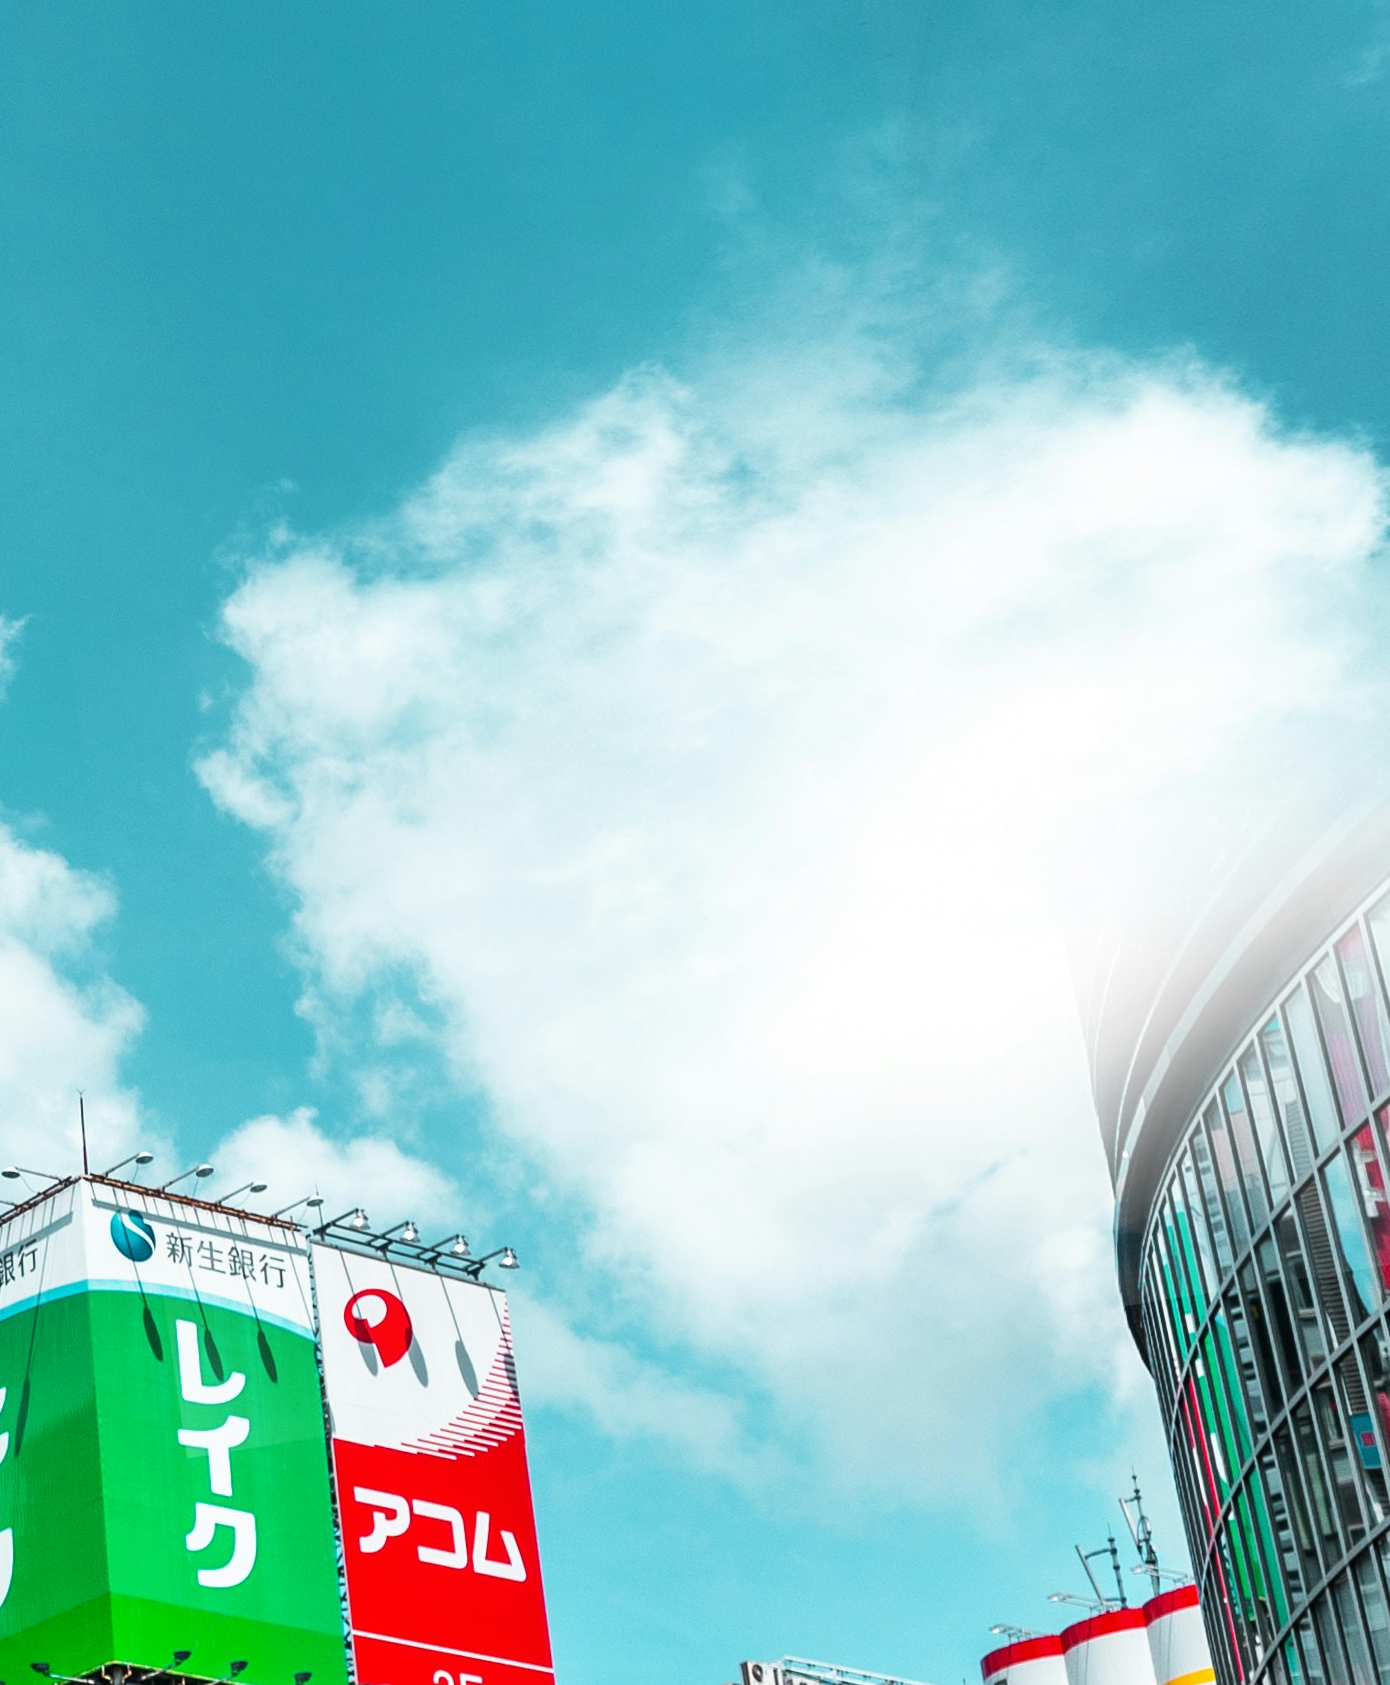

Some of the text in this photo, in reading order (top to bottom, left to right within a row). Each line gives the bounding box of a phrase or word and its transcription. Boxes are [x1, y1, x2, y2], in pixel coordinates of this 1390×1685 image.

[165, 1232, 287, 1290] 新生銀行
[175, 1318, 258, 1589] レイク
[353, 1486, 528, 1584] アコム
